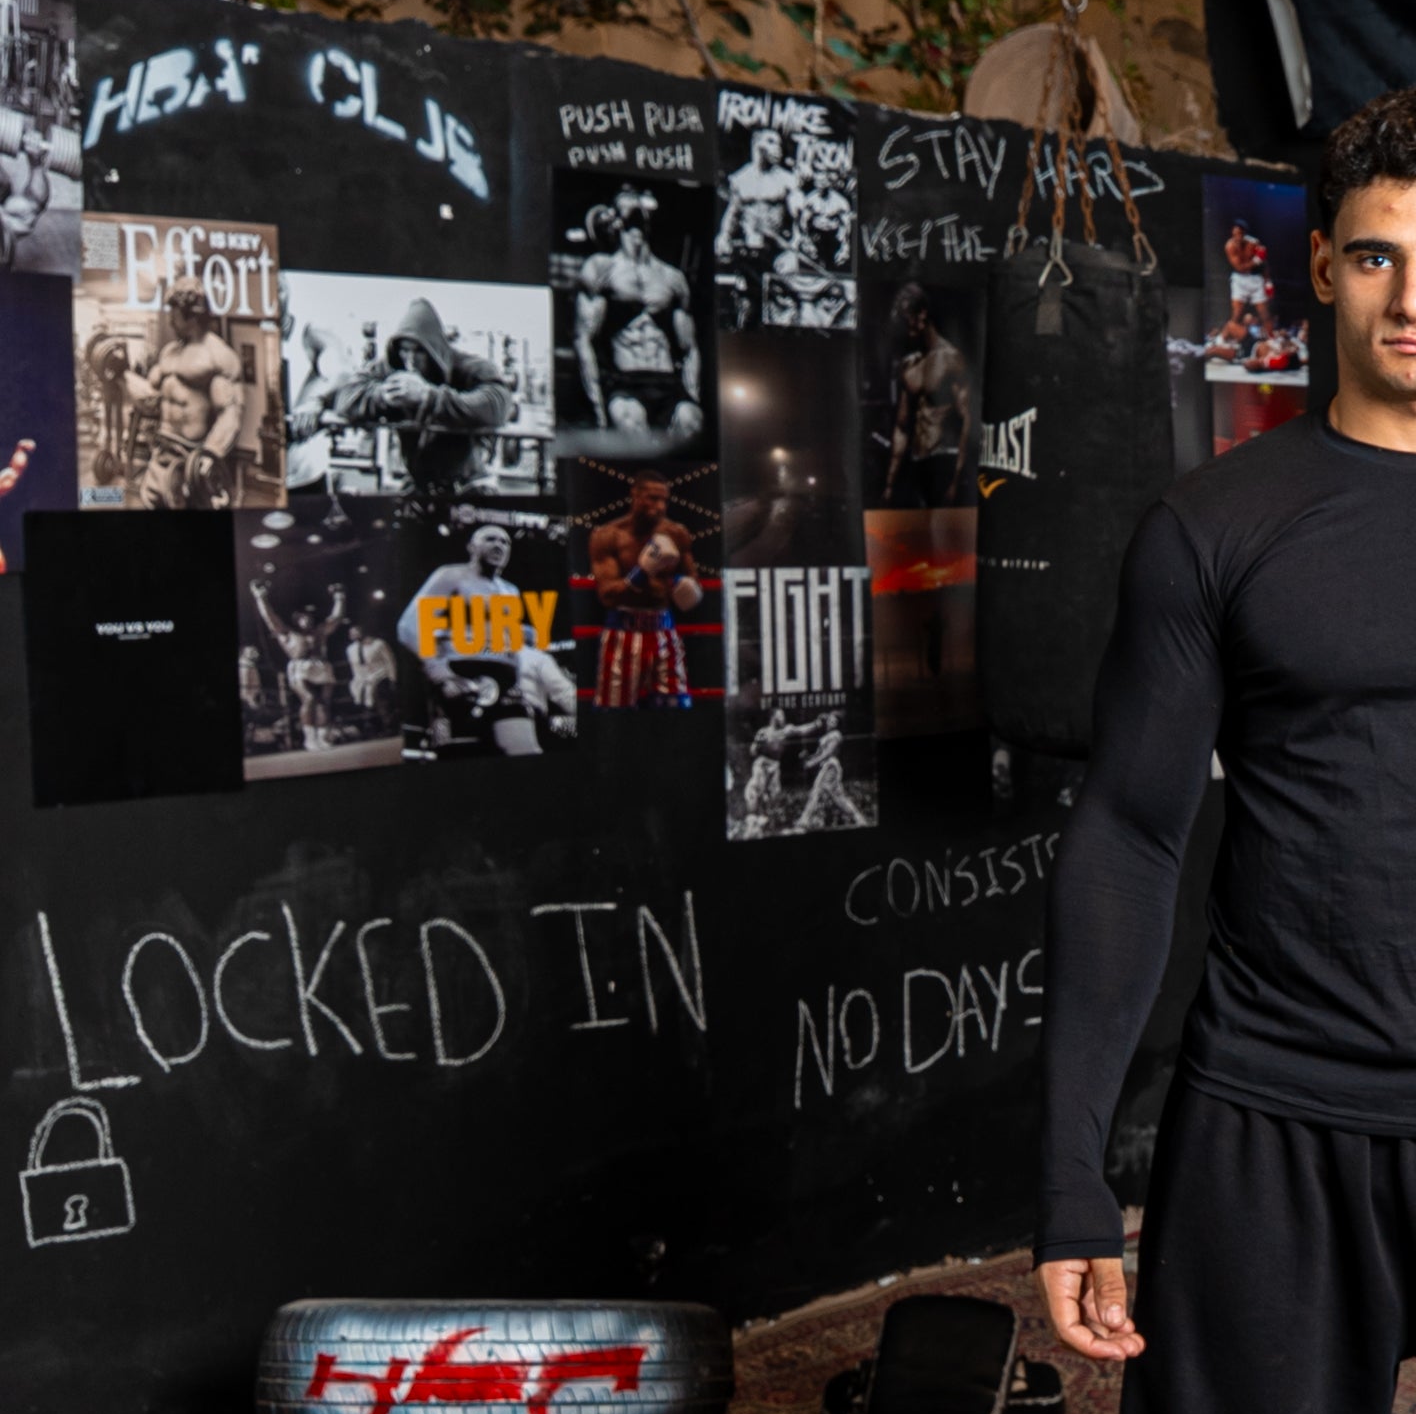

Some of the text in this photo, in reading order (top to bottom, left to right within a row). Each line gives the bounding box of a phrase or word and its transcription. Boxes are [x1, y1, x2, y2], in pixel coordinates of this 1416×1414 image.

[559, 98, 705, 138] PUSH PUSH
[717, 89, 834, 135] IRON MIKE
[635, 142, 694, 172] PUSH
[878, 124, 1166, 202] STAY HARD
[227, 231, 262, 253] KEY
[935, 212, 998, 263] THE
[121, 222, 277, 318] Effort
[95, 619, 174, 636] YOU VS YOU
[417, 590, 559, 660] FURY
[723, 566, 872, 697] FIGHT
[37, 889, 707, 1091] LOCKED IN
[794, 983, 881, 1109] NO
